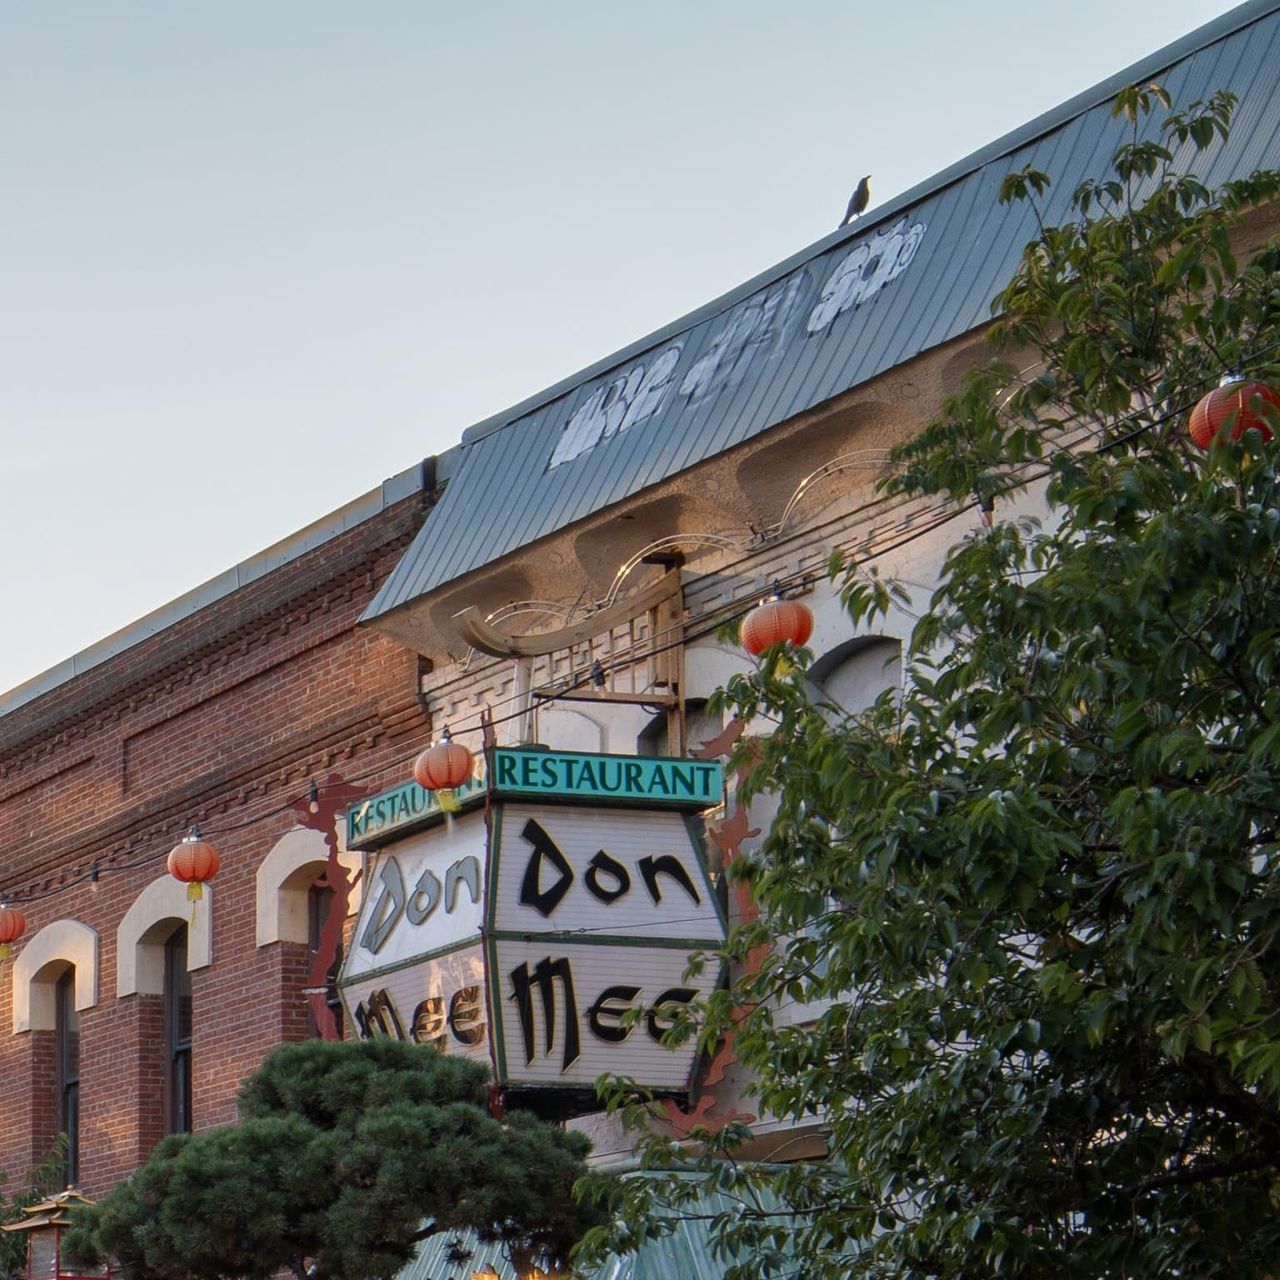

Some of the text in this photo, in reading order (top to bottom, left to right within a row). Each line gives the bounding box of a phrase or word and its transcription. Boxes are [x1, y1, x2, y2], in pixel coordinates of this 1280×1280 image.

[497, 754, 717, 797] RESTAURANT
[359, 854, 481, 955] Don
[519, 817, 701, 918] Don
[509, 955, 702, 1075] Mee
